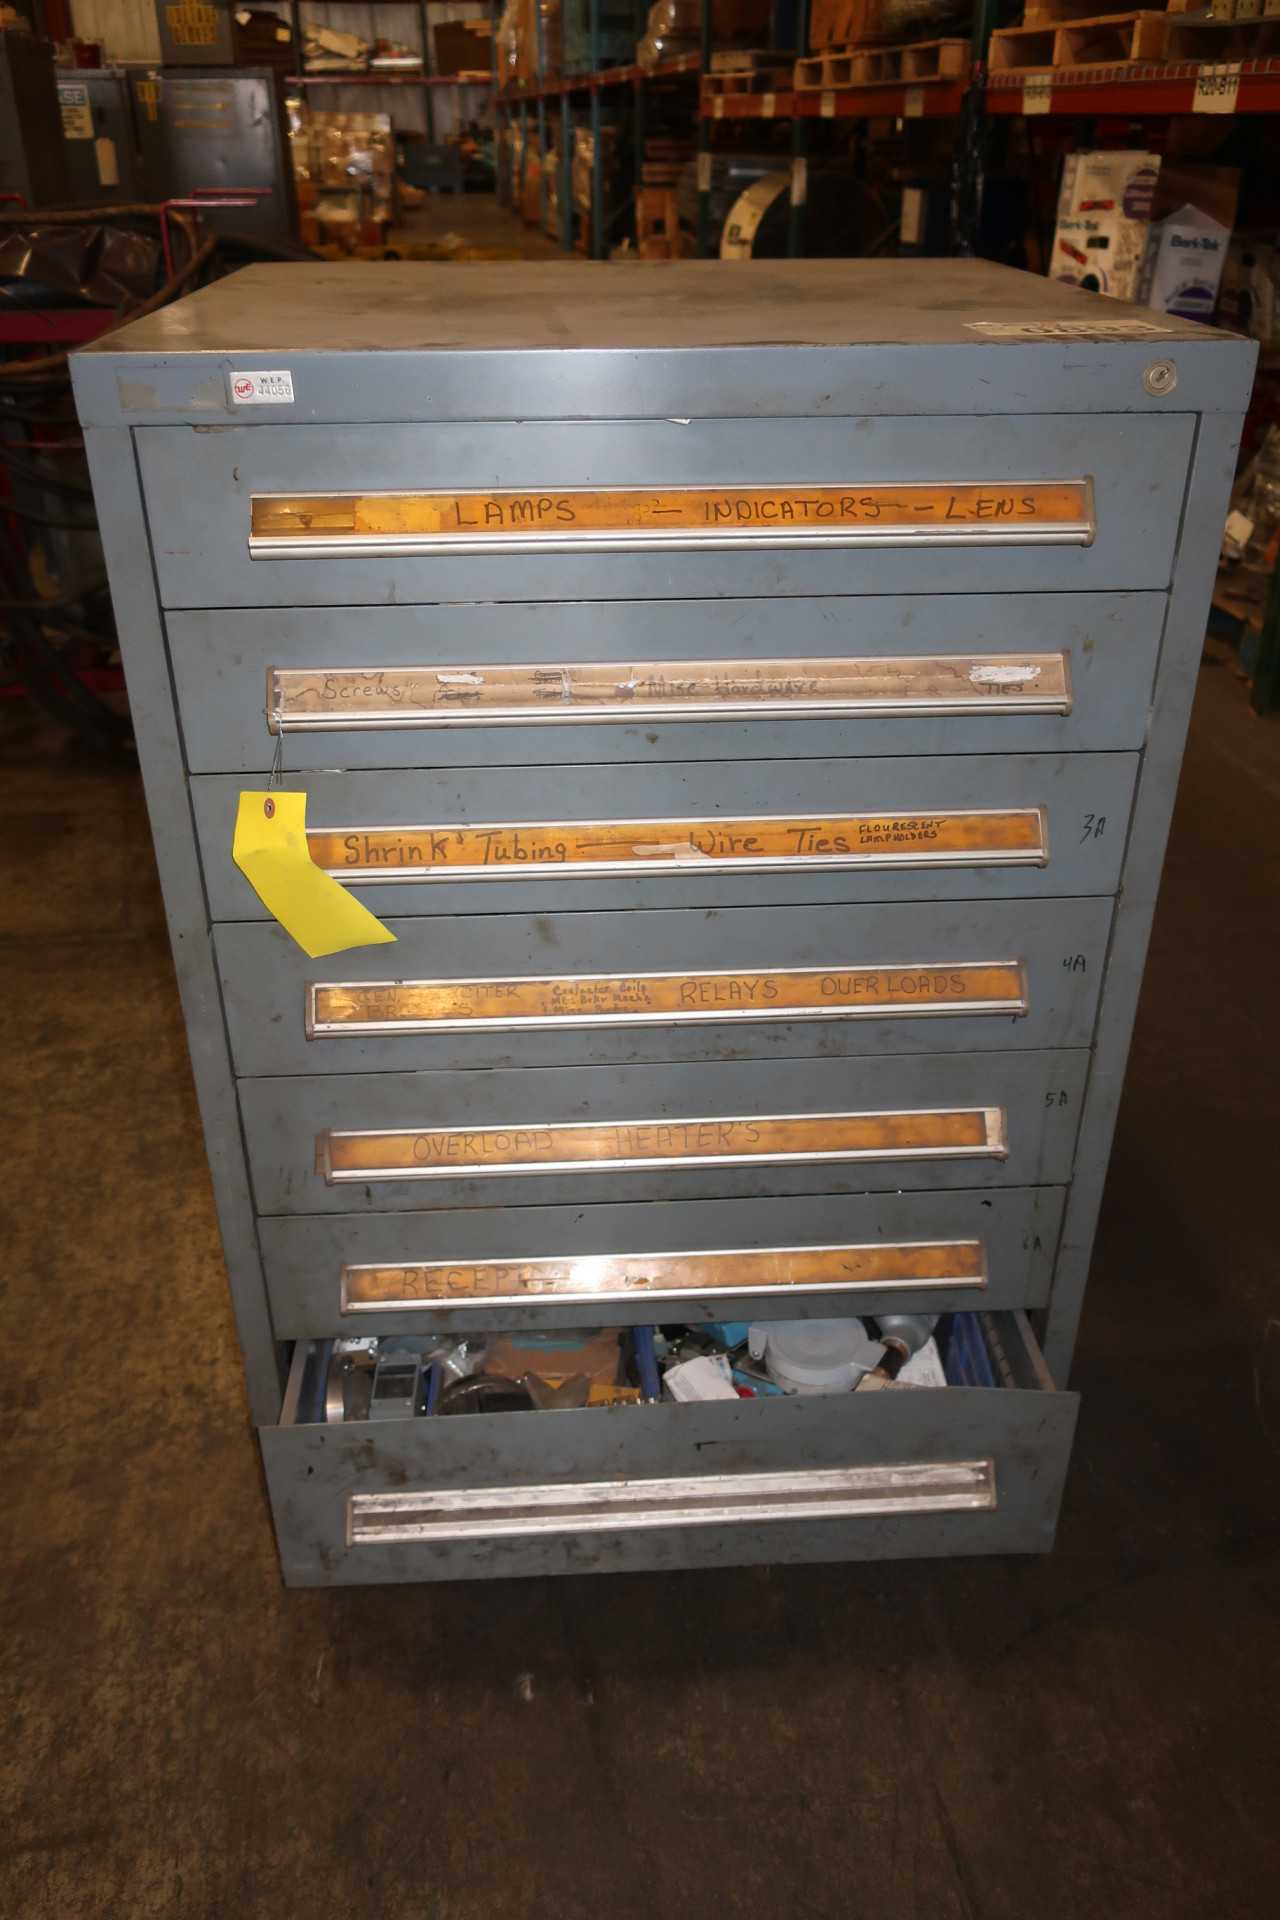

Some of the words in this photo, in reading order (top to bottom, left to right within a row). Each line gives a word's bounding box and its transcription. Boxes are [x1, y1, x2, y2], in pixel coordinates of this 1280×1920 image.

[454, 497, 577, 526] LAMPS
[704, 496, 881, 521] INDICATORS
[945, 496, 1037, 520] LENS
[324, 679, 401, 699] Screws
[1080, 813, 1107, 845] 3A
[344, 832, 450, 865] Shrink
[475, 830, 567, 865] Tubing
[689, 830, 764, 855] Wire
[786, 827, 850, 854] Ties
[1062, 953, 1087, 973] 4A
[680, 978, 779, 1005] RELAYS
[1045, 1090, 1069, 1107] 5A
[412, 1131, 553, 1161] OVERLOAD
